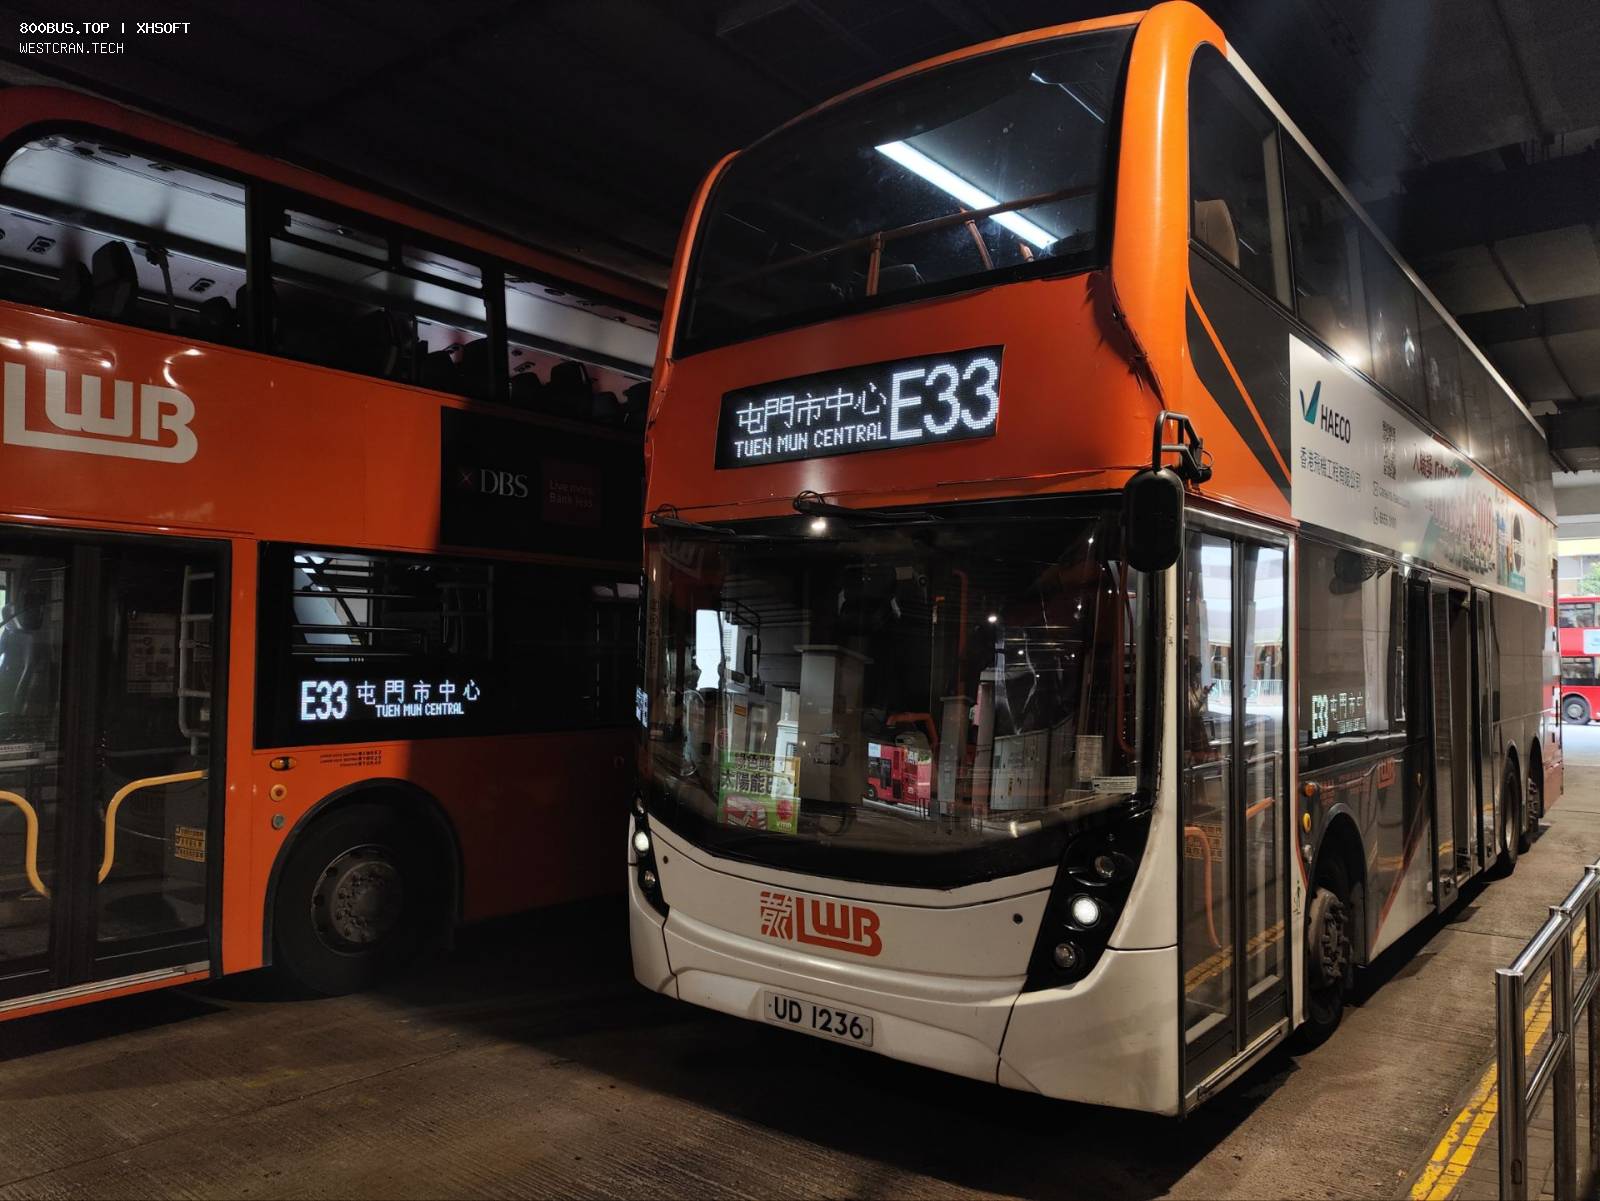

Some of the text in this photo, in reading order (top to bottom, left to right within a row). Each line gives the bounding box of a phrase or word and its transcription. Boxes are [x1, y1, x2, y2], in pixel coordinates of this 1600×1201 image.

[3, 361, 198, 464] LWB
[735, 382, 887, 435] 屯門市中心
[889, 357, 999, 441] E33
[735, 421, 888, 458] TUEN MUN CENTRAL
[1320, 404, 1351, 444] HAECO
[480, 468, 529, 499] DBS
[300, 679, 349, 721] E33
[355, 678, 482, 706] 屯門市中心
[375, 701, 465, 718] TUEN MUN CENTRAL
[1312, 693, 1329, 740] E33
[795, 896, 882, 957] LWB
[774, 996, 864, 1039] UD 1236
